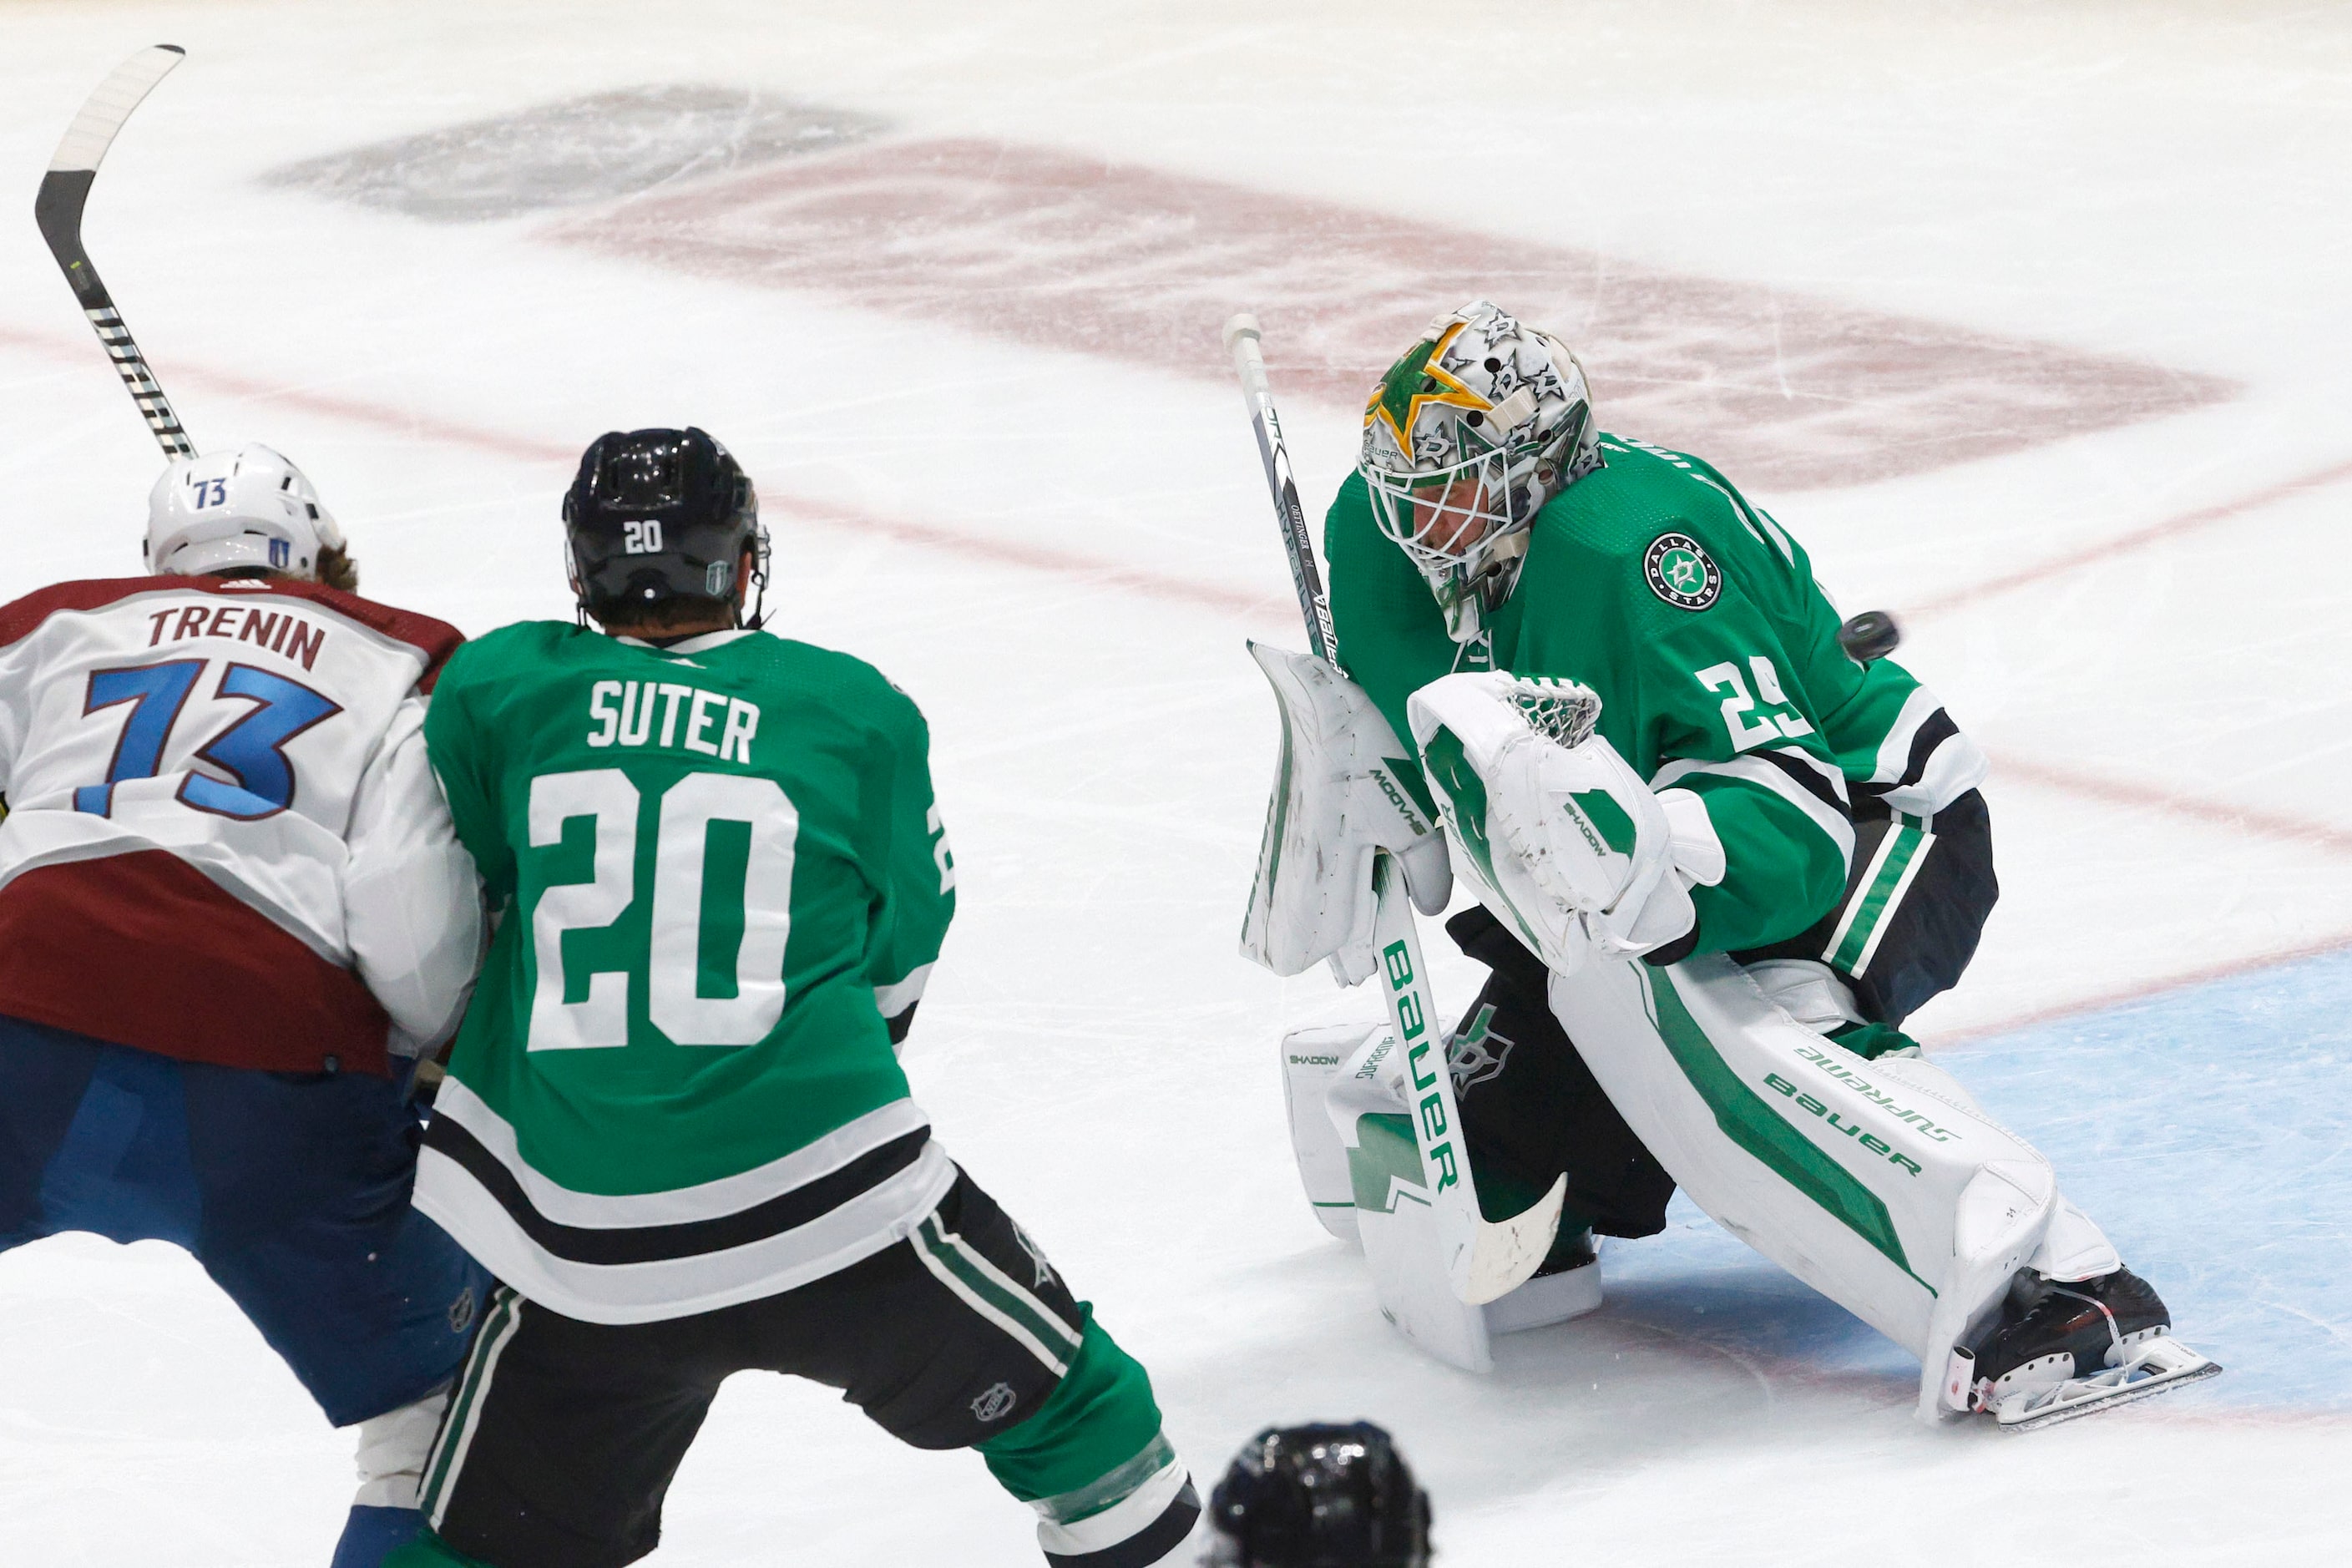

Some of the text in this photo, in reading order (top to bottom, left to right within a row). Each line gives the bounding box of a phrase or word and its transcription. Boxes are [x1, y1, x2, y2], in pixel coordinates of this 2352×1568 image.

[193, 478, 227, 509] 73
[623, 519, 663, 554] 20
[1291, 504, 1310, 549] OETTINGER
[1650, 537, 1705, 578] DALLAS
[1669, 574, 1718, 605] STARS
[149, 606, 326, 671] TRENIN
[587, 680, 760, 765] SUTER
[1694, 655, 1816, 753] 29
[73, 659, 345, 822] 73
[1368, 769, 1428, 837] SHADOW
[1562, 802, 1607, 857] SHADOW
[526, 767, 800, 1052] 20
[1289, 1055, 1339, 1065] SHADOW
[1793, 1045, 1962, 1143] SUPREME
